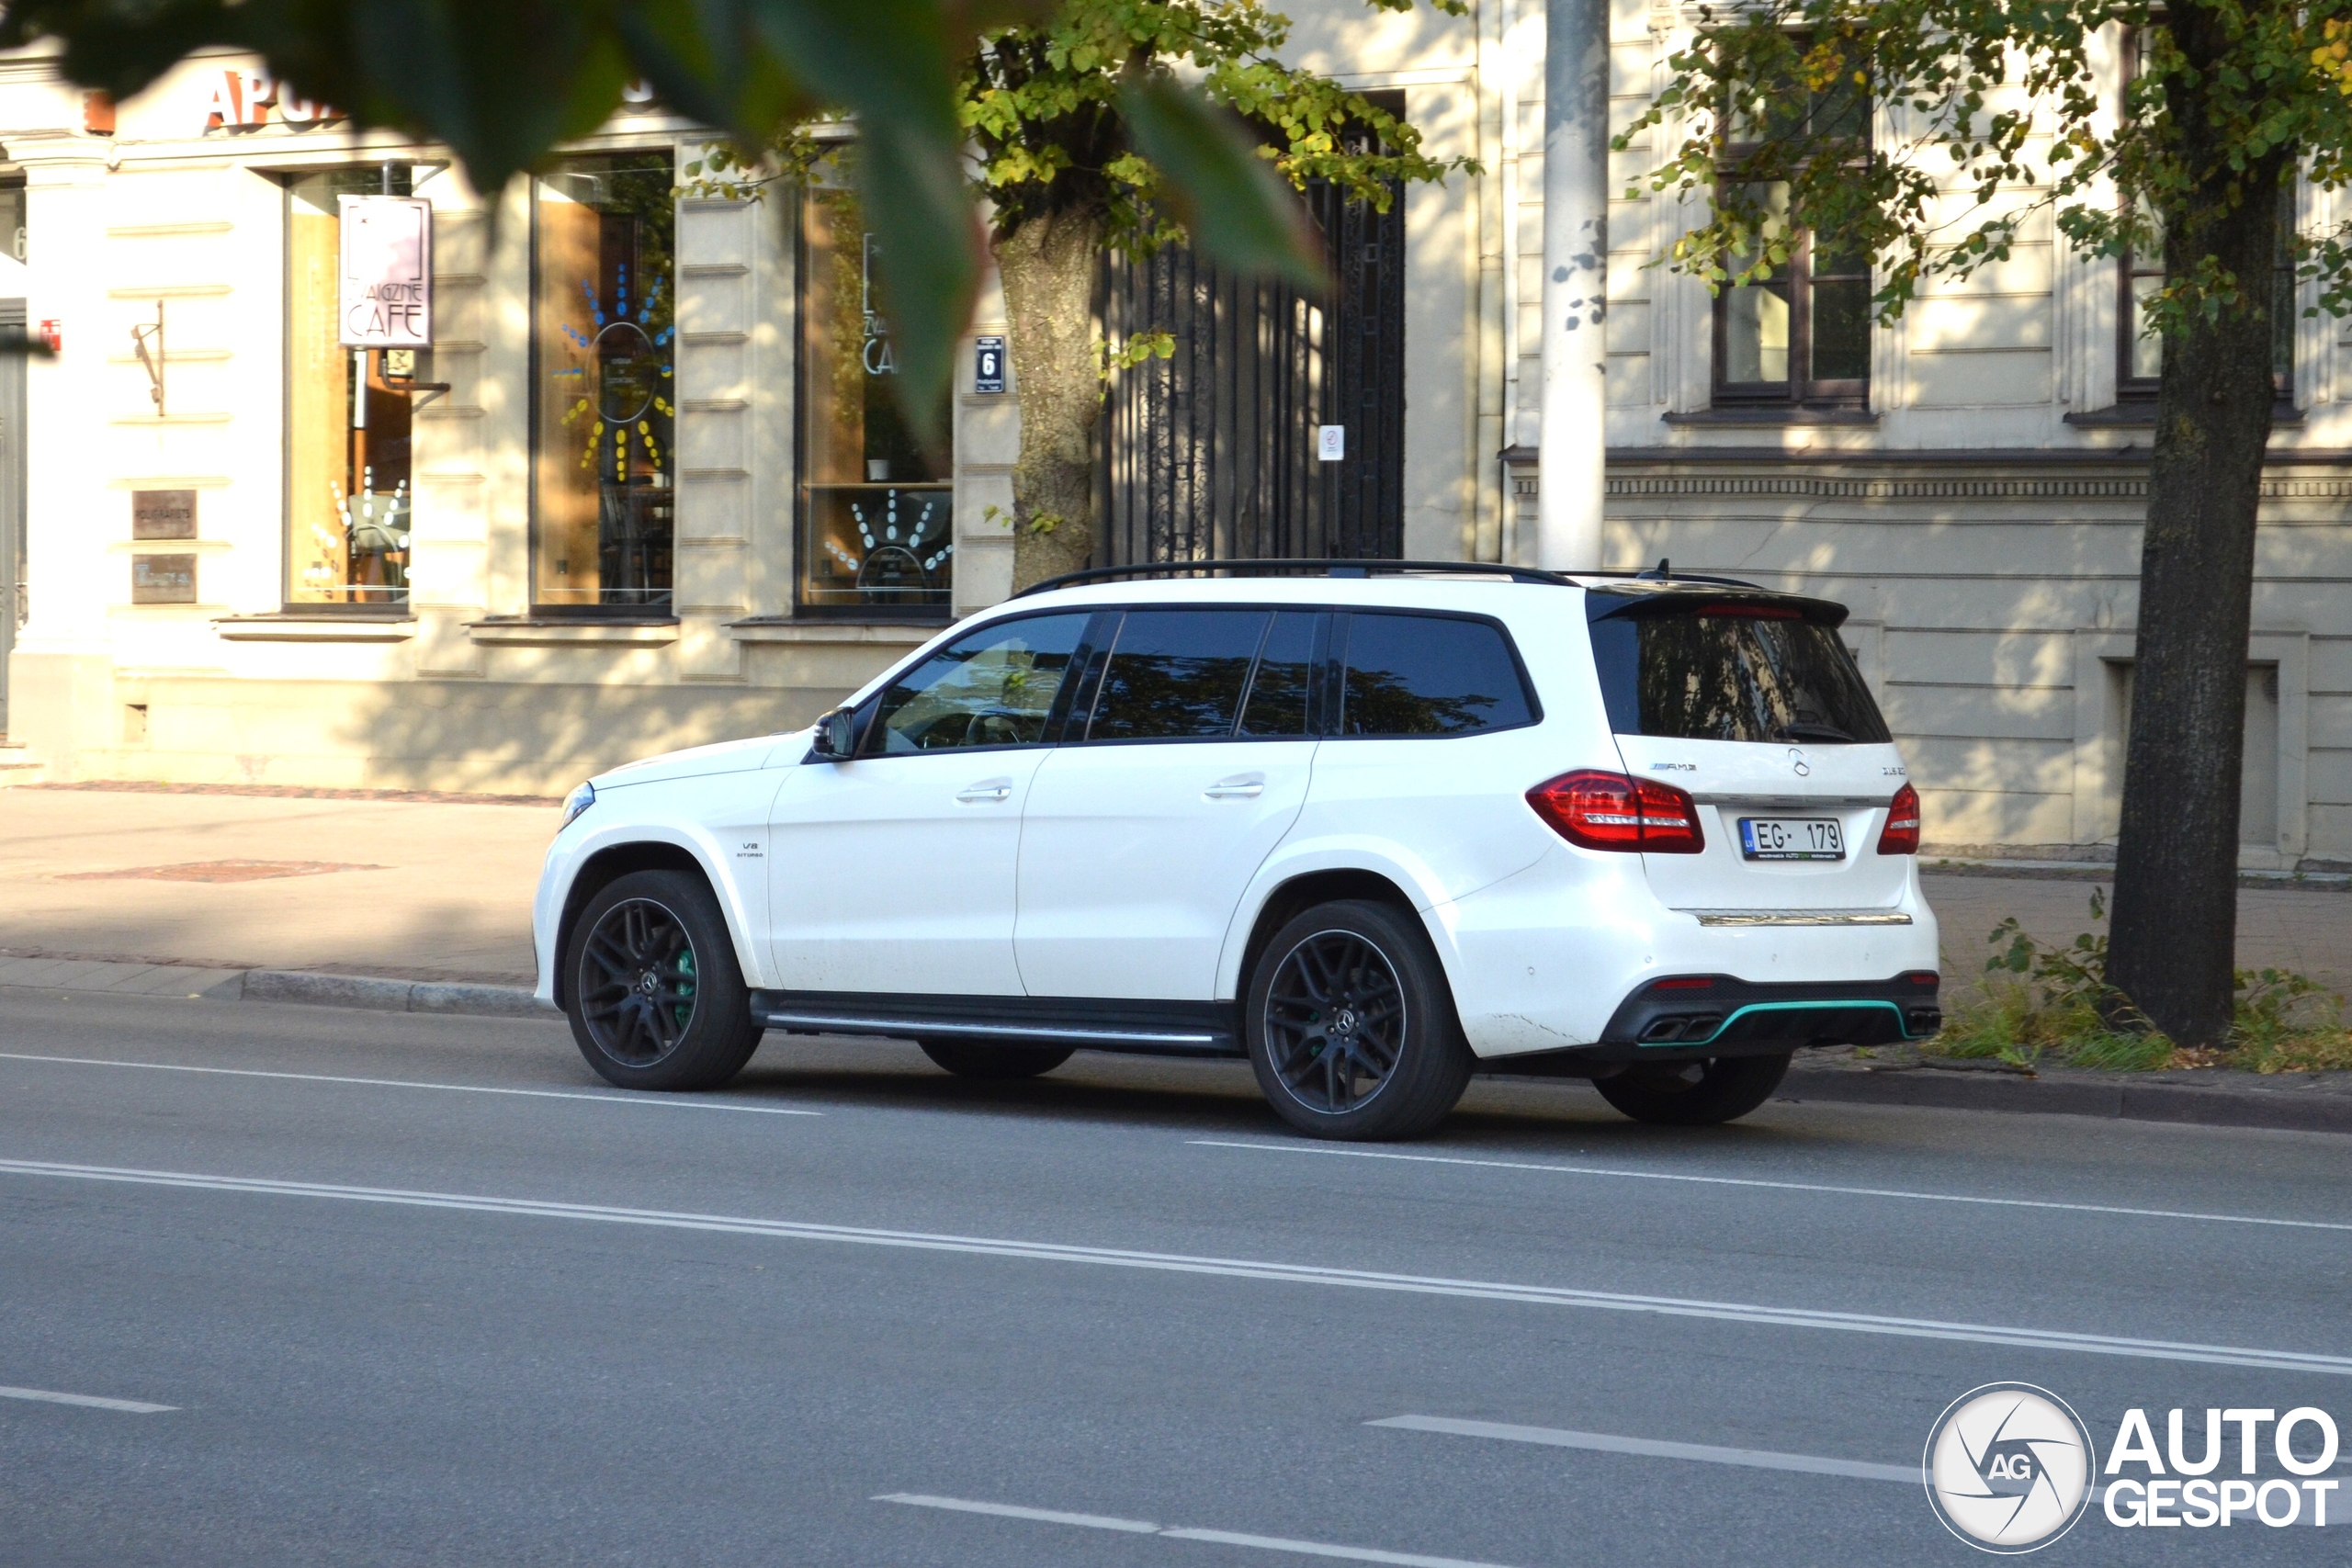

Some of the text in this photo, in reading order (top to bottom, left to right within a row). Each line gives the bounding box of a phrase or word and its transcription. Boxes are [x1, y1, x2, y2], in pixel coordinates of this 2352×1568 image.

[347, 304, 422, 338] CAFE
[982, 352, 995, 375] 6
[1667, 762, 1697, 771] AMG
[1746, 840, 1754, 848] LV
[1806, 823, 1838, 850] 179
